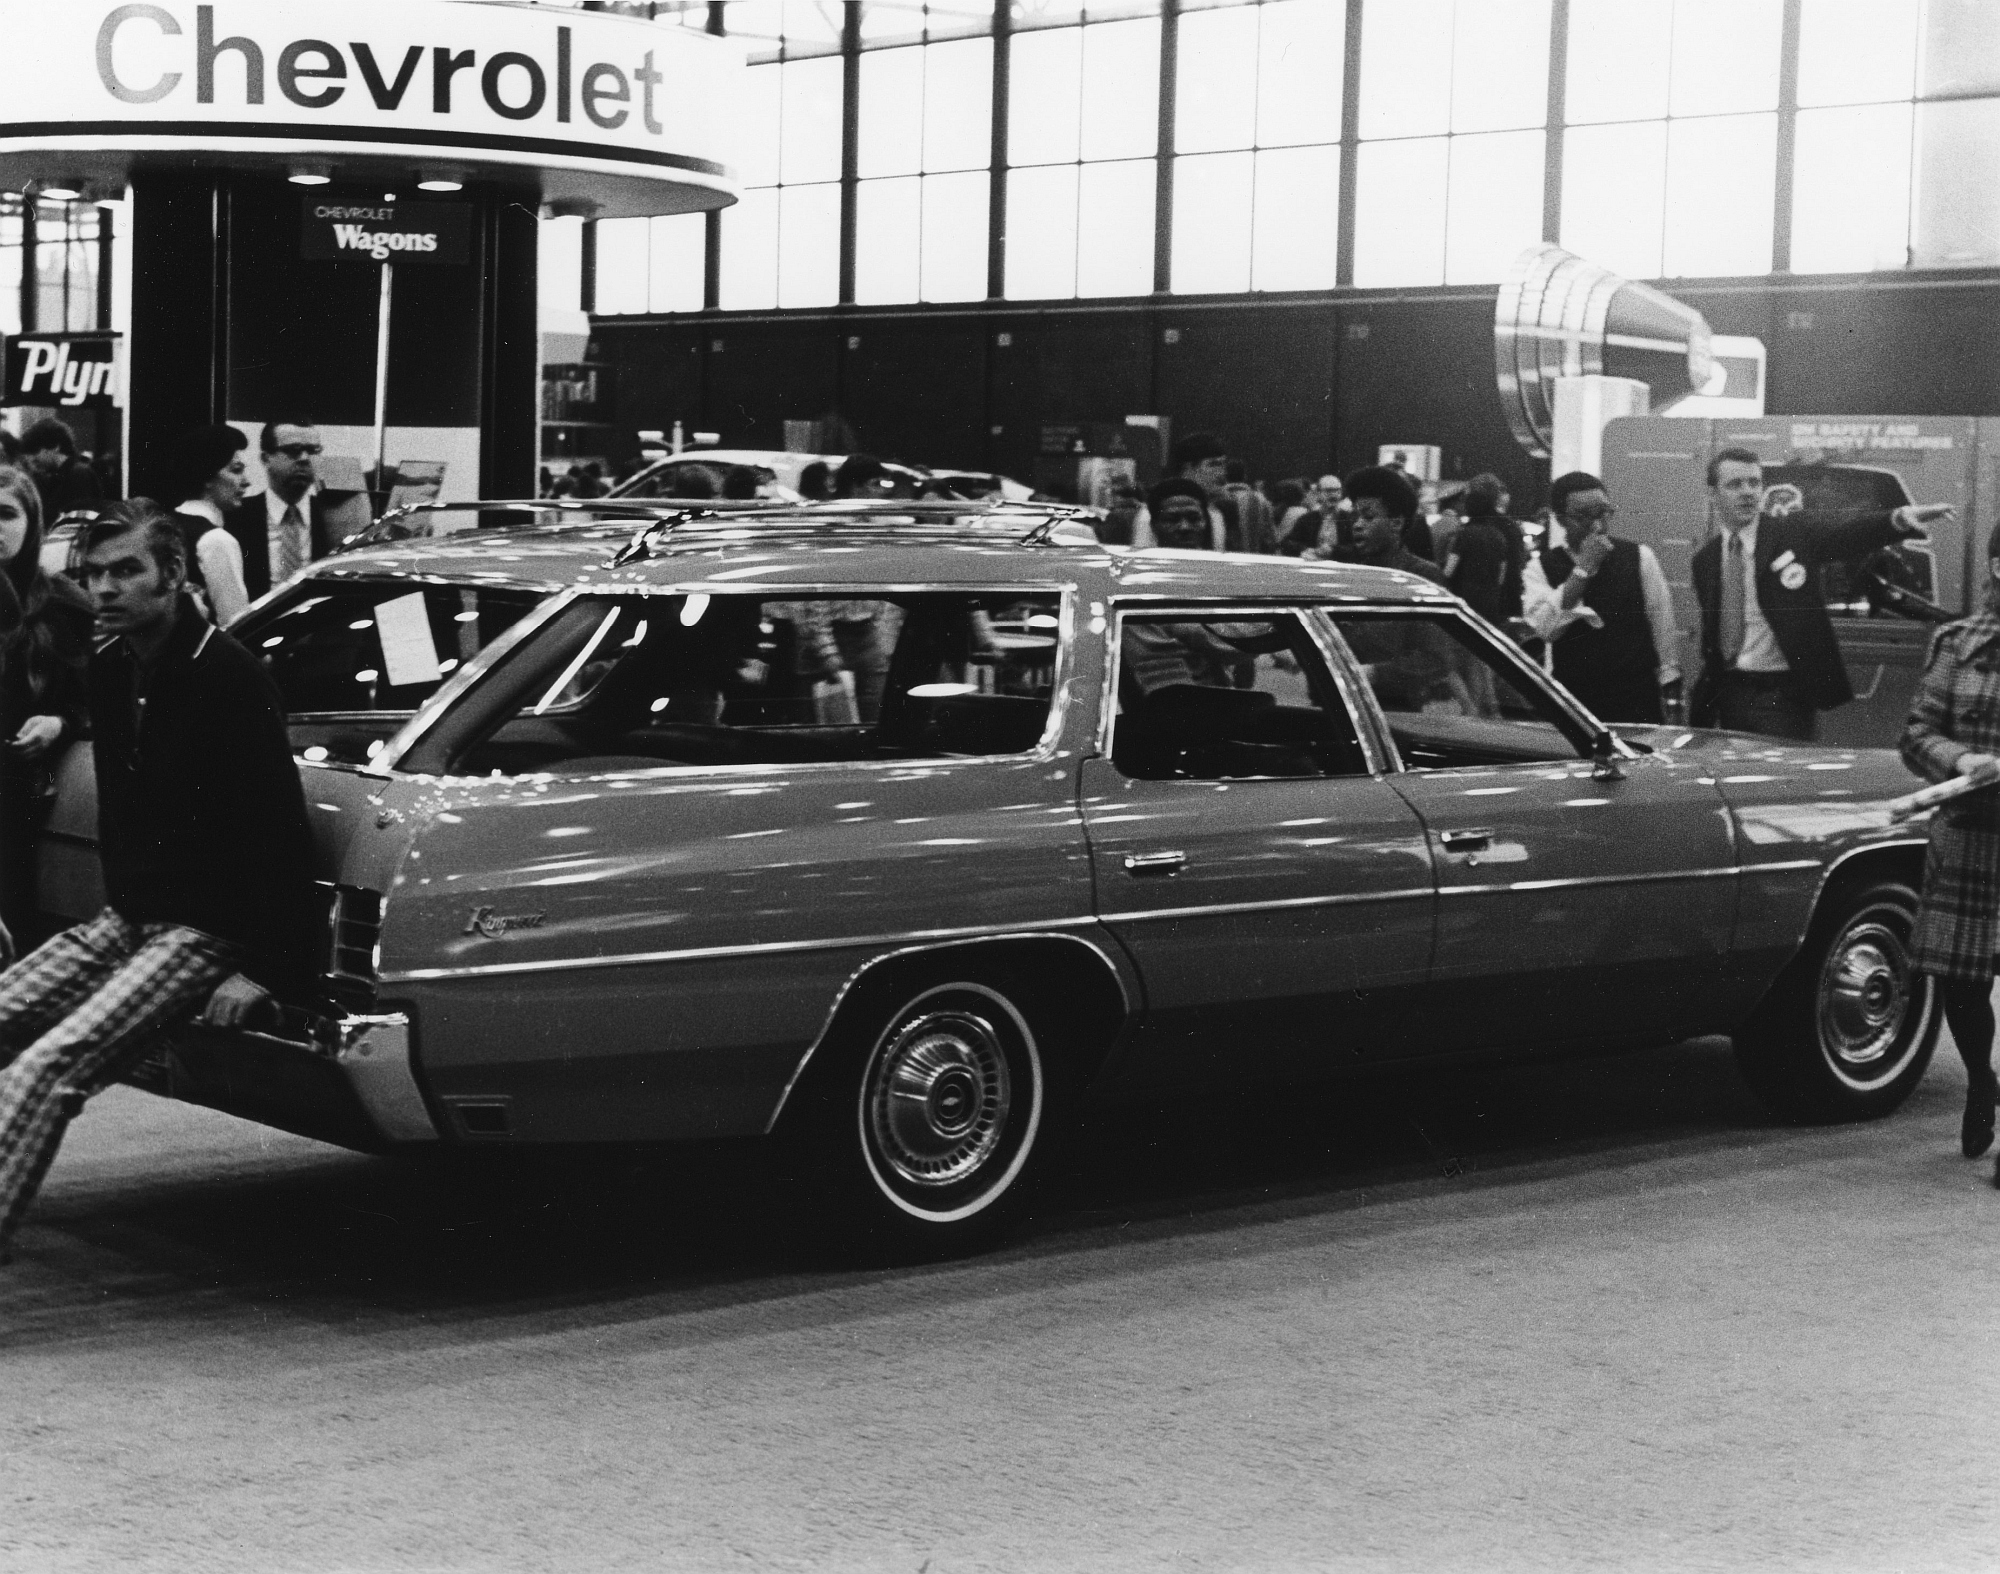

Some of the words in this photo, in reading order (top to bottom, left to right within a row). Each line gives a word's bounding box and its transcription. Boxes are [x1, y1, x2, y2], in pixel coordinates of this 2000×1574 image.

[95, 3, 663, 136] Chevrolet
[314, 205, 394, 221] CHEVROLET
[332, 223, 438, 260] Wagons
[1819, 423, 1881, 436] SAFETY
[1885, 424, 1919, 437] AND
[1791, 436, 1866, 449] SECURITY
[1869, 436, 1953, 449] FEATURES
